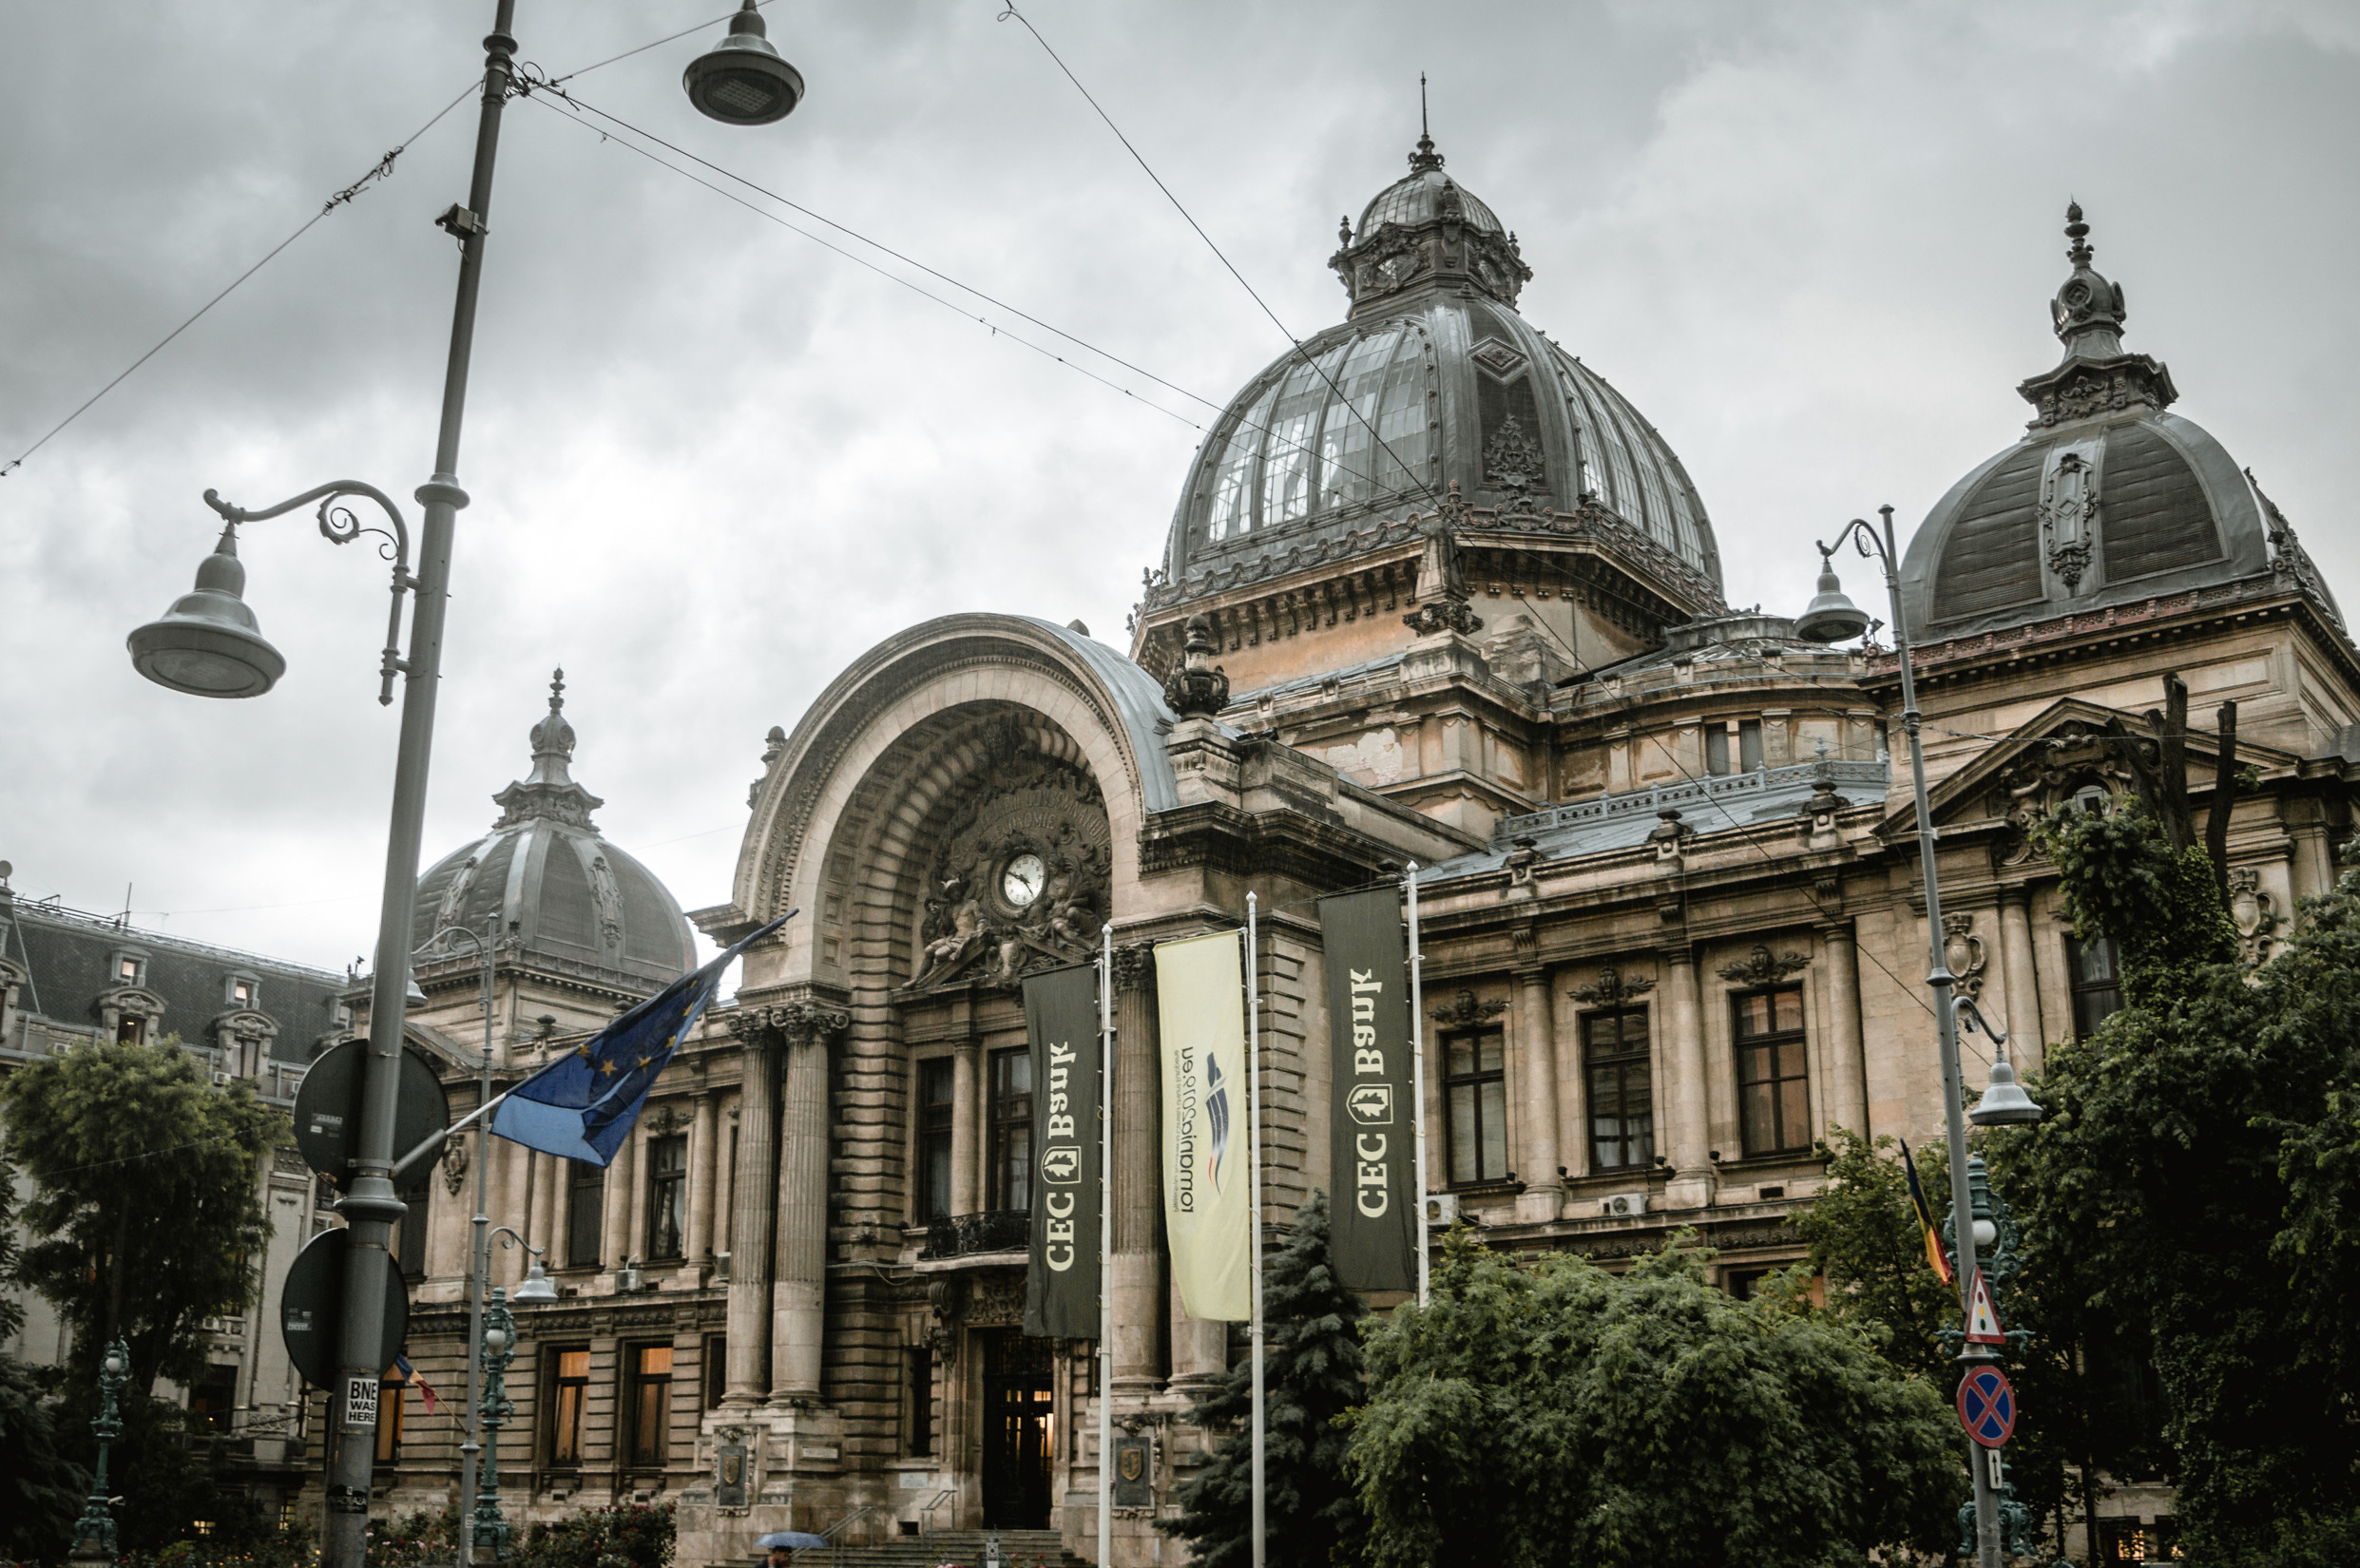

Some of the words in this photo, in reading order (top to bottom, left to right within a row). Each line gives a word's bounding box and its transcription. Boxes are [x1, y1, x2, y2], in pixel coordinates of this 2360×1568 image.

[350, 1381, 376, 1400] BNE
[350, 1401, 375, 1411] WAS
[349, 1412, 374, 1423] HERE
